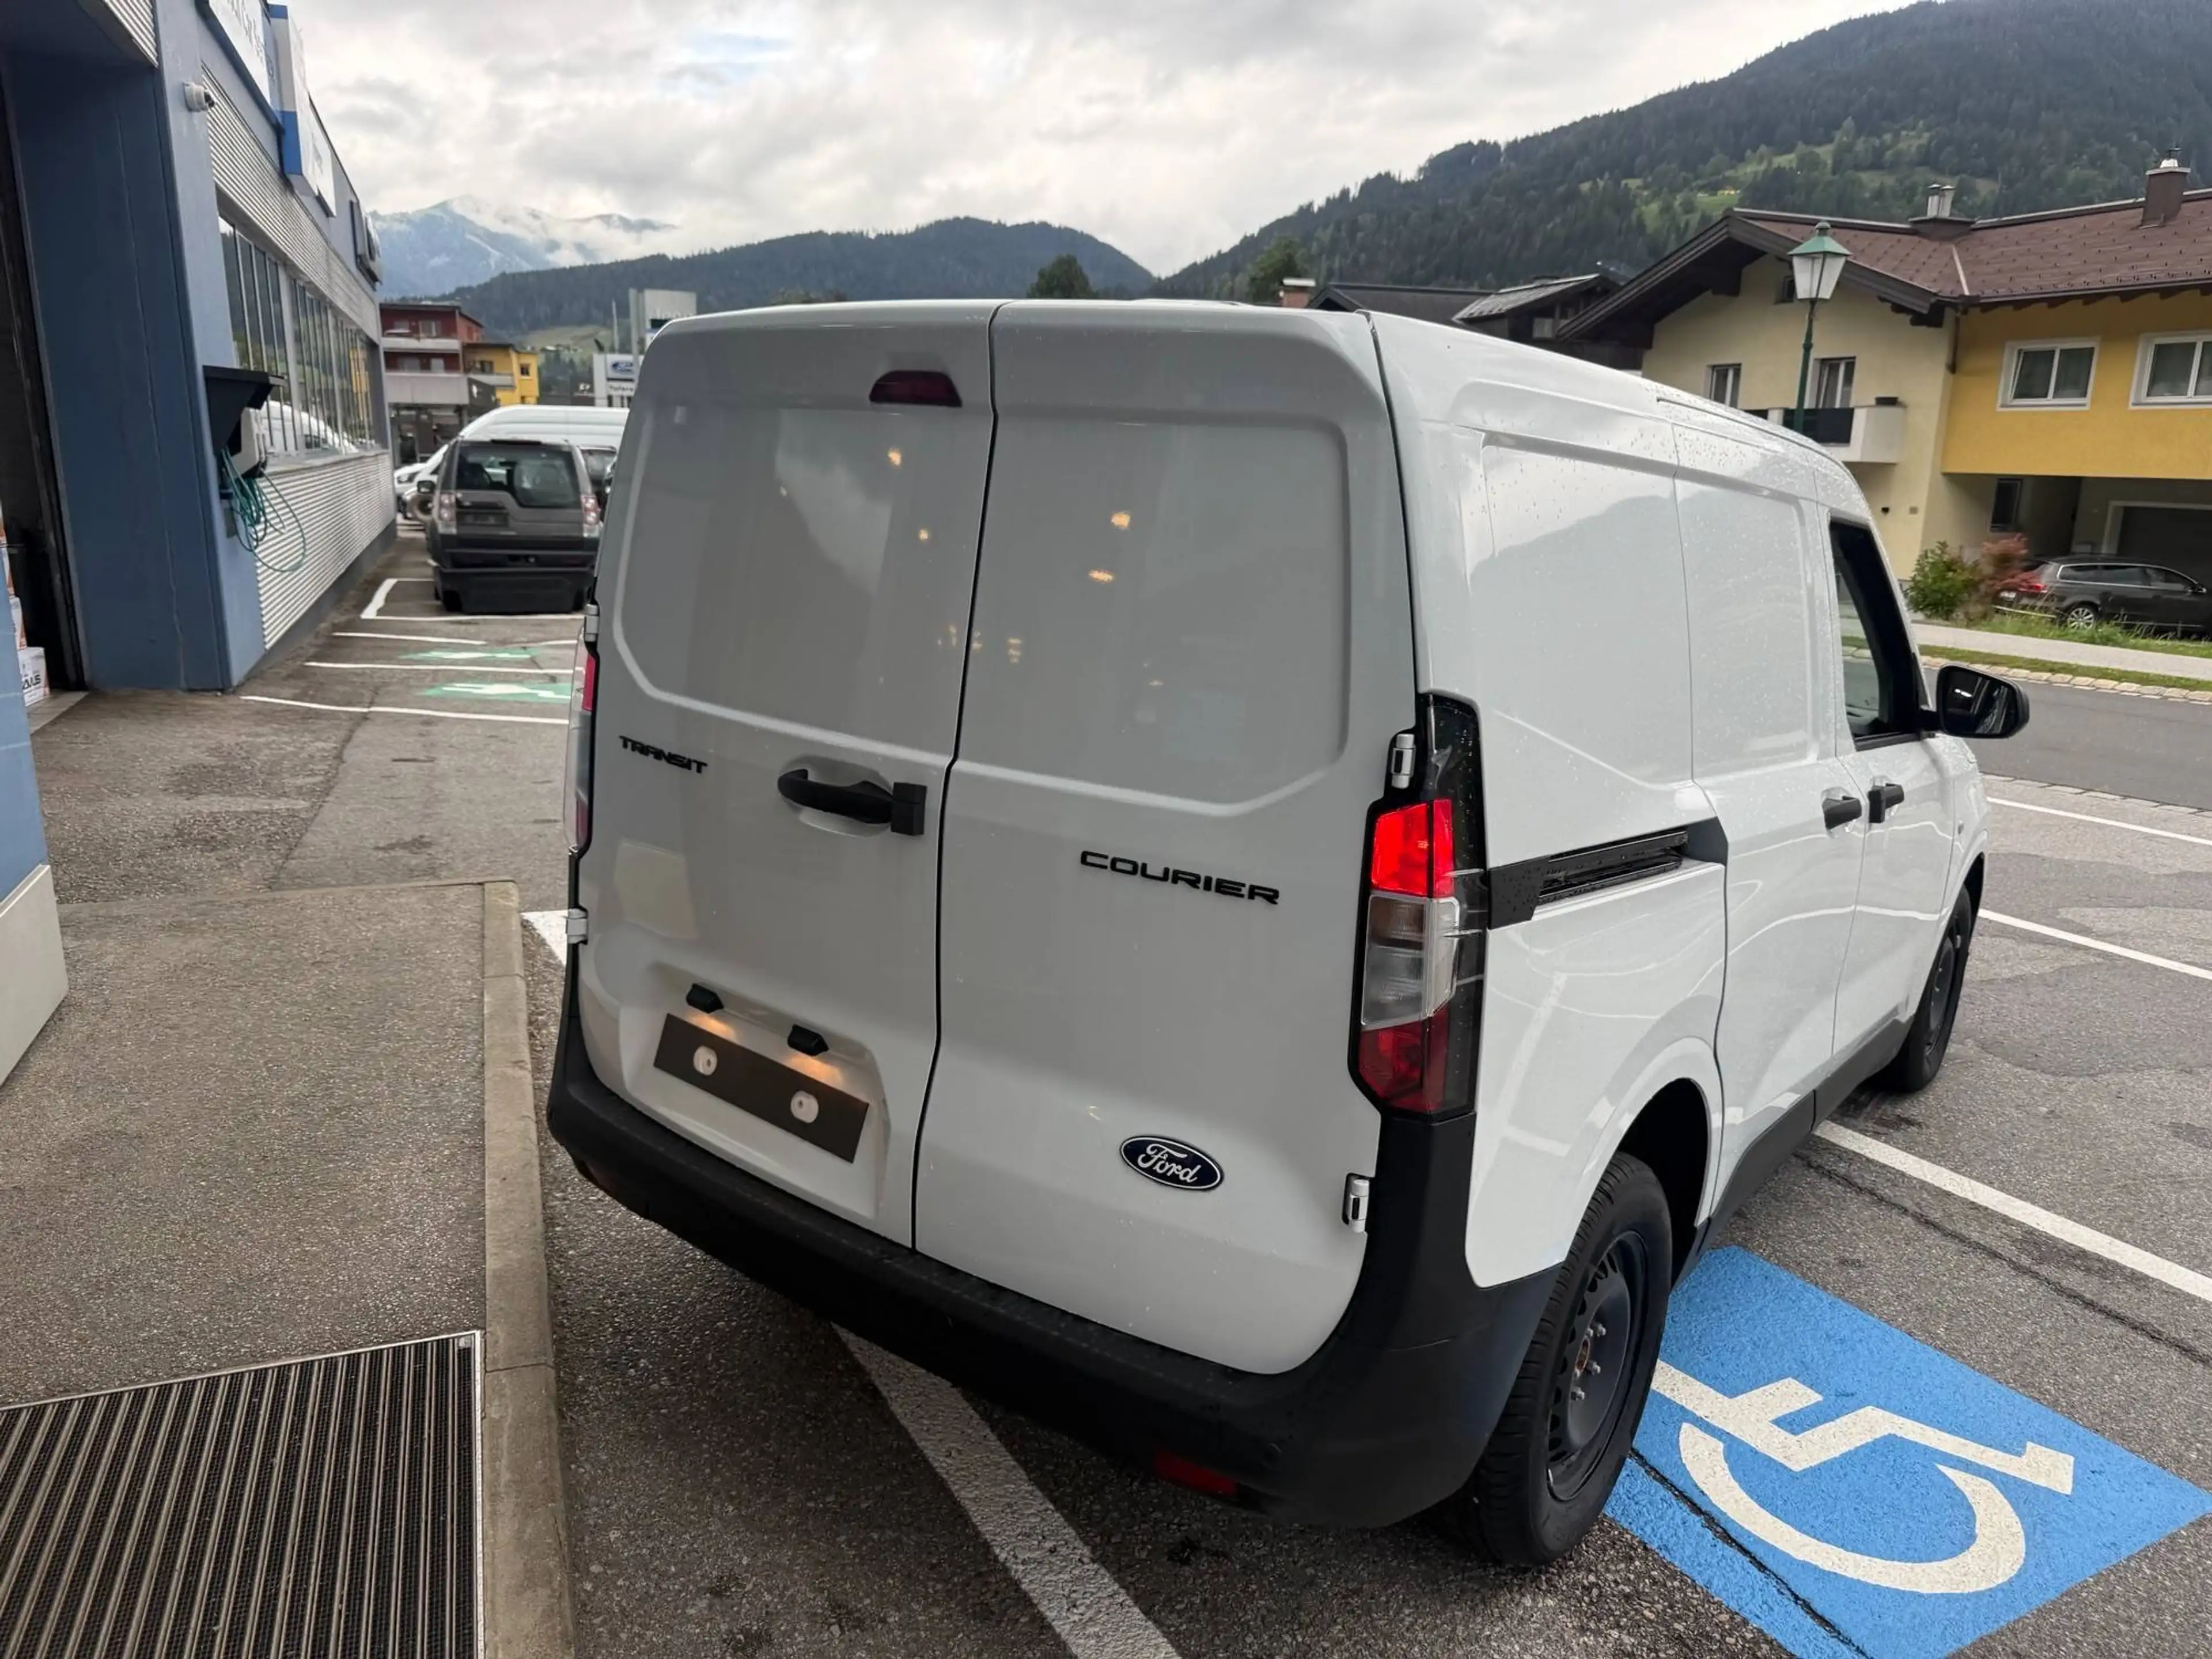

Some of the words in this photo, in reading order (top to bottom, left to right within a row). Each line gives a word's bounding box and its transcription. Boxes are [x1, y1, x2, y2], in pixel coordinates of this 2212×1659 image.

[619, 736, 708, 774] TRANSIT
[1080, 850, 1280, 905] COURIER
[1137, 1143, 1202, 1183] Ford
